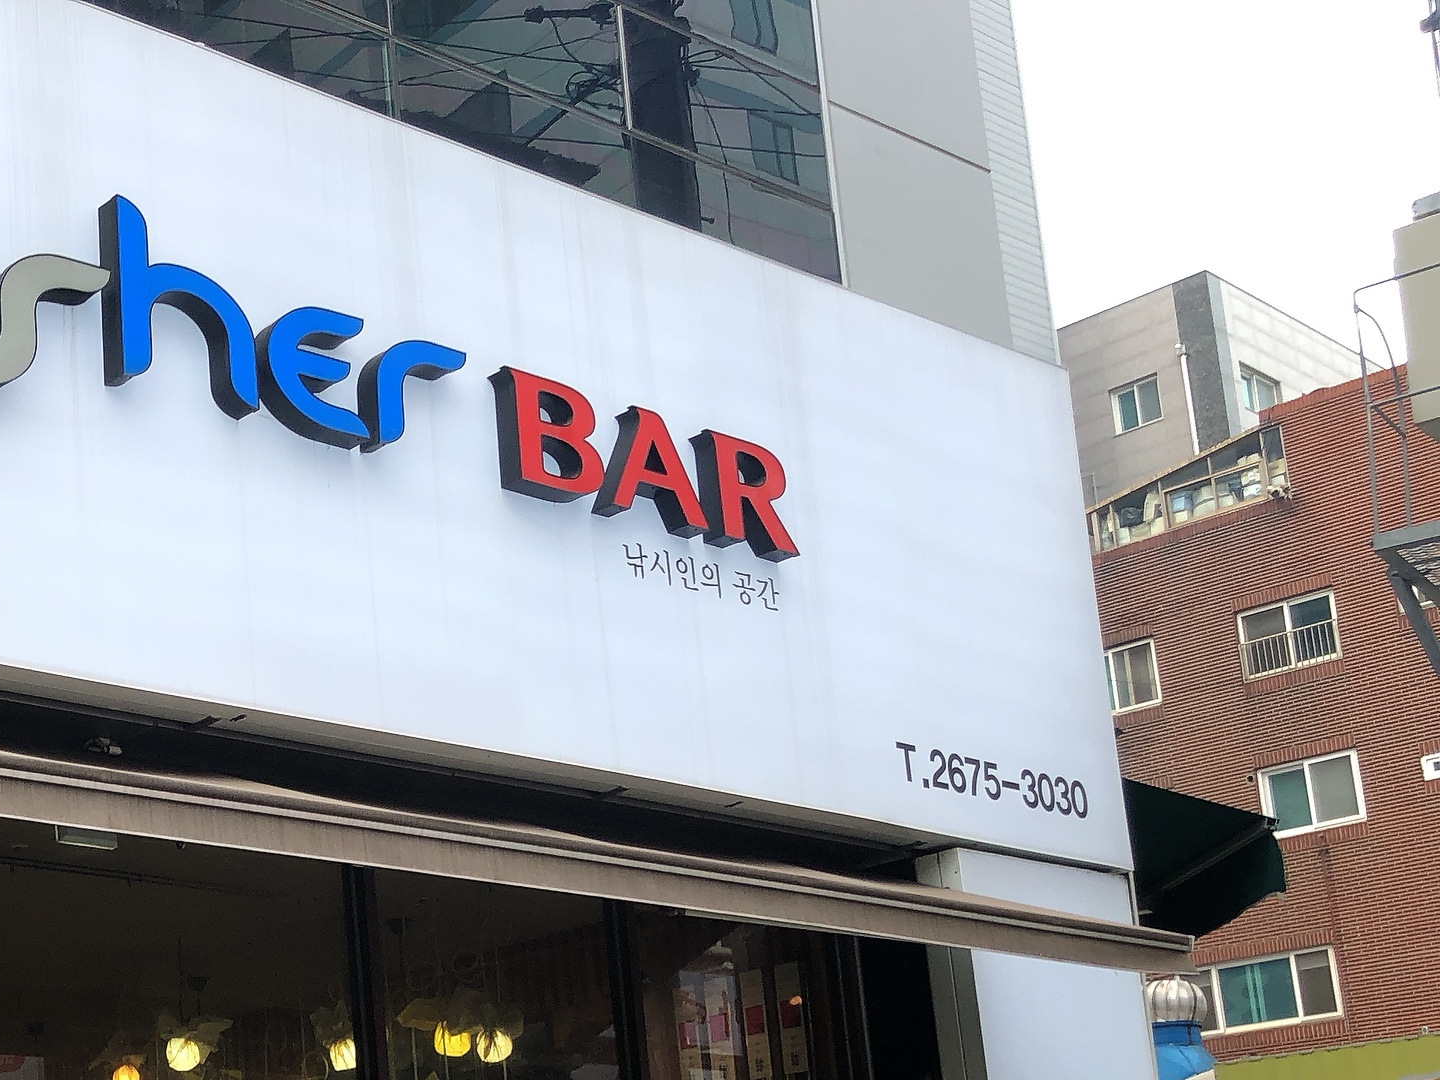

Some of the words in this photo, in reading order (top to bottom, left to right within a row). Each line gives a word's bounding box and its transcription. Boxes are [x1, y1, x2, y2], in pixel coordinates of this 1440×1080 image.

[488, 365, 801, 563] BAR
[622, 542, 723, 600] 낚시인의
[732, 570, 780, 613] 공간
[895, 740, 1089, 820] T.2675-3030
